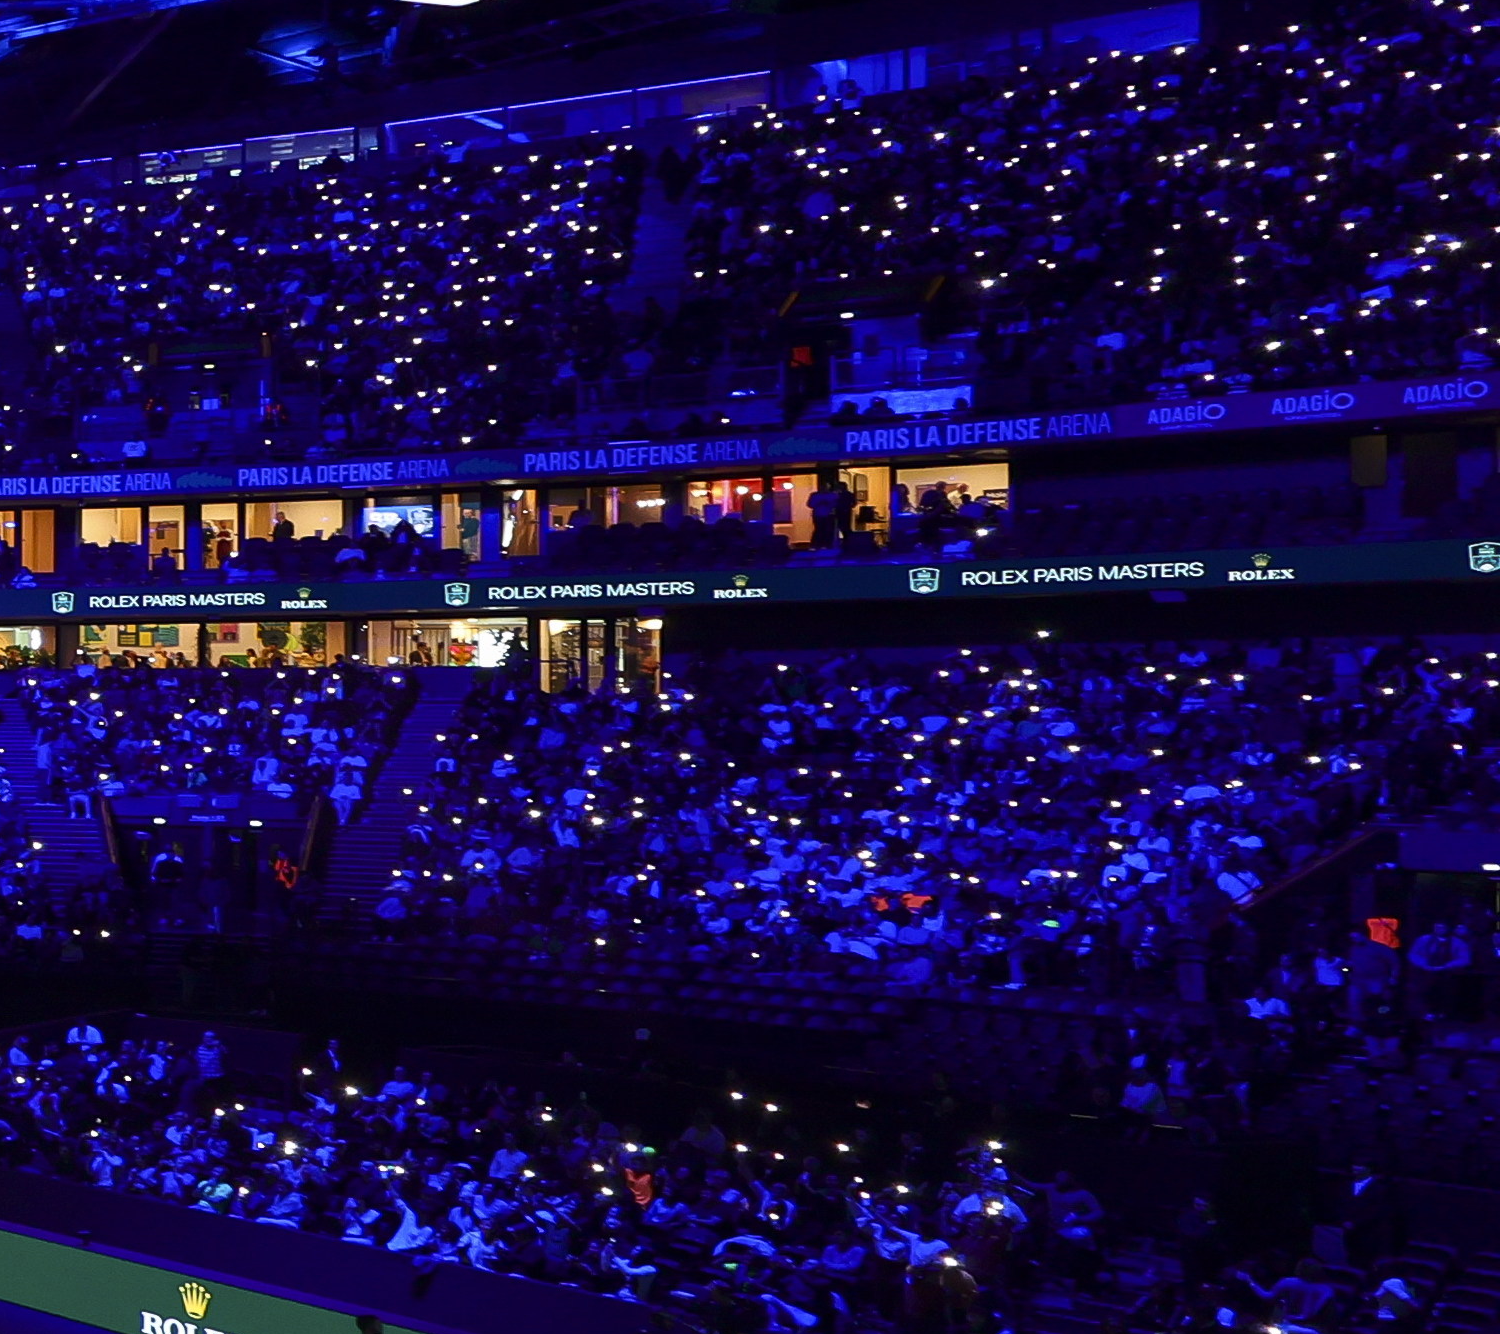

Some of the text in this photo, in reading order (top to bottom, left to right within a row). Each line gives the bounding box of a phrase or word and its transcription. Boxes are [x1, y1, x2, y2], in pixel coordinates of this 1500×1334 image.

[845, 412, 1111, 451] PARIS LA DEFENSE ARENA
[523, 439, 760, 472] PARIS LA DEFENSE ARENA
[238, 459, 448, 486] PARIS LA DEFENSE ARENA
[30, 477, 49, 495] LA
[51, 474, 121, 494] DEFENSE
[124, 472, 171, 491] ARENA
[961, 562, 1205, 585] ROLEX PARIS MASTERS
[1227, 568, 1295, 581] ROLEX
[89, 592, 266, 608] ROLEX PARIS MASTERS
[488, 581, 695, 600] ROLEX PARIS MASTERS
[713, 588, 768, 599] ROLEX
[280, 599, 328, 609] ROLEX
